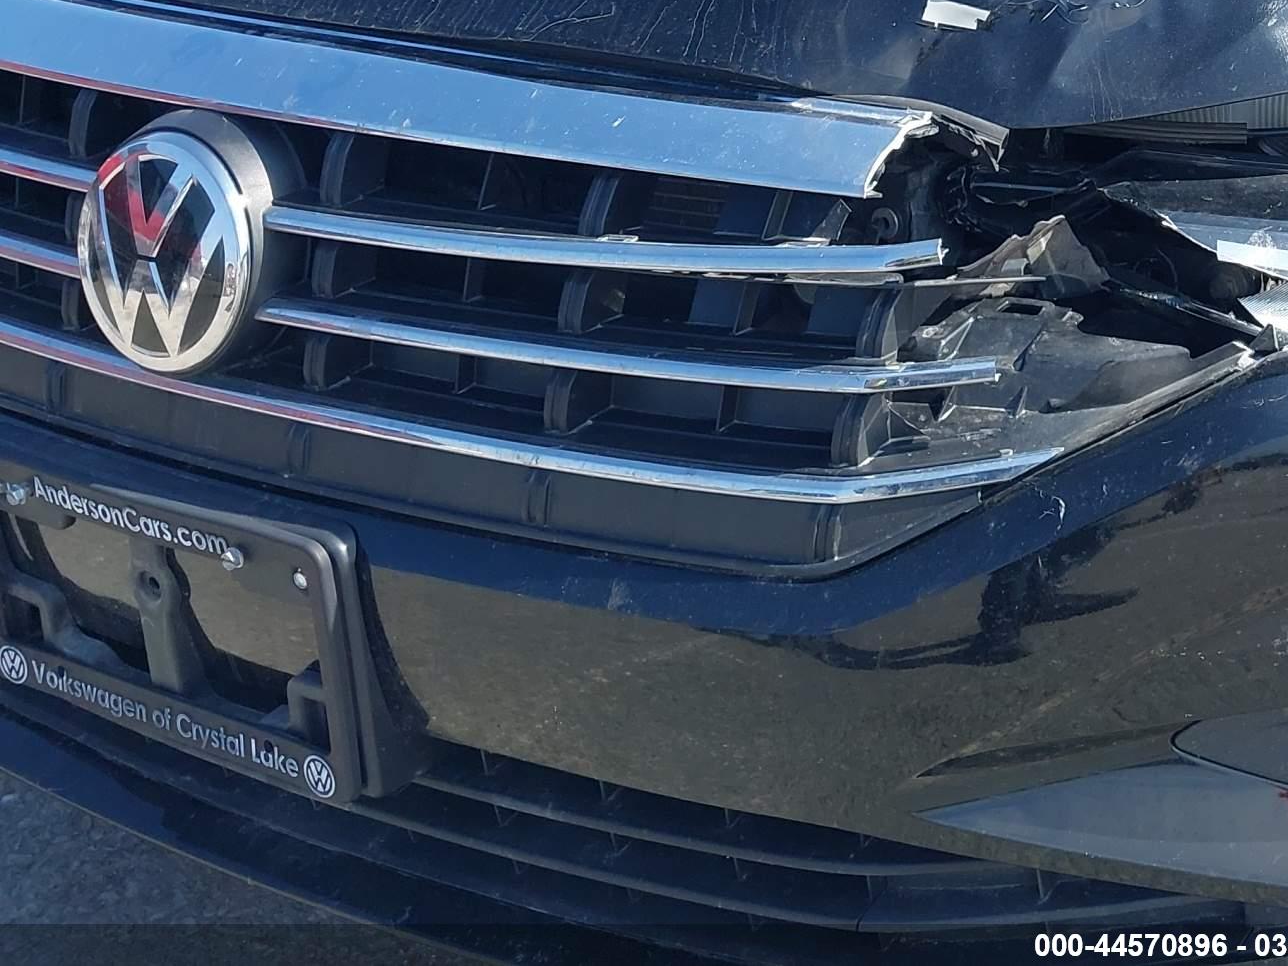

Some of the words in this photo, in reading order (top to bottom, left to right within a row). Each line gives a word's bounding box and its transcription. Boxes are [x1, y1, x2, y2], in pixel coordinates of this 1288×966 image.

[32, 475, 229, 556] AndersonCars.com
[31, 659, 148, 723] Volkswagen
[152, 706, 172, 732] of
[175, 713, 246, 758] Crystal
[250, 737, 300, 779] Lake
